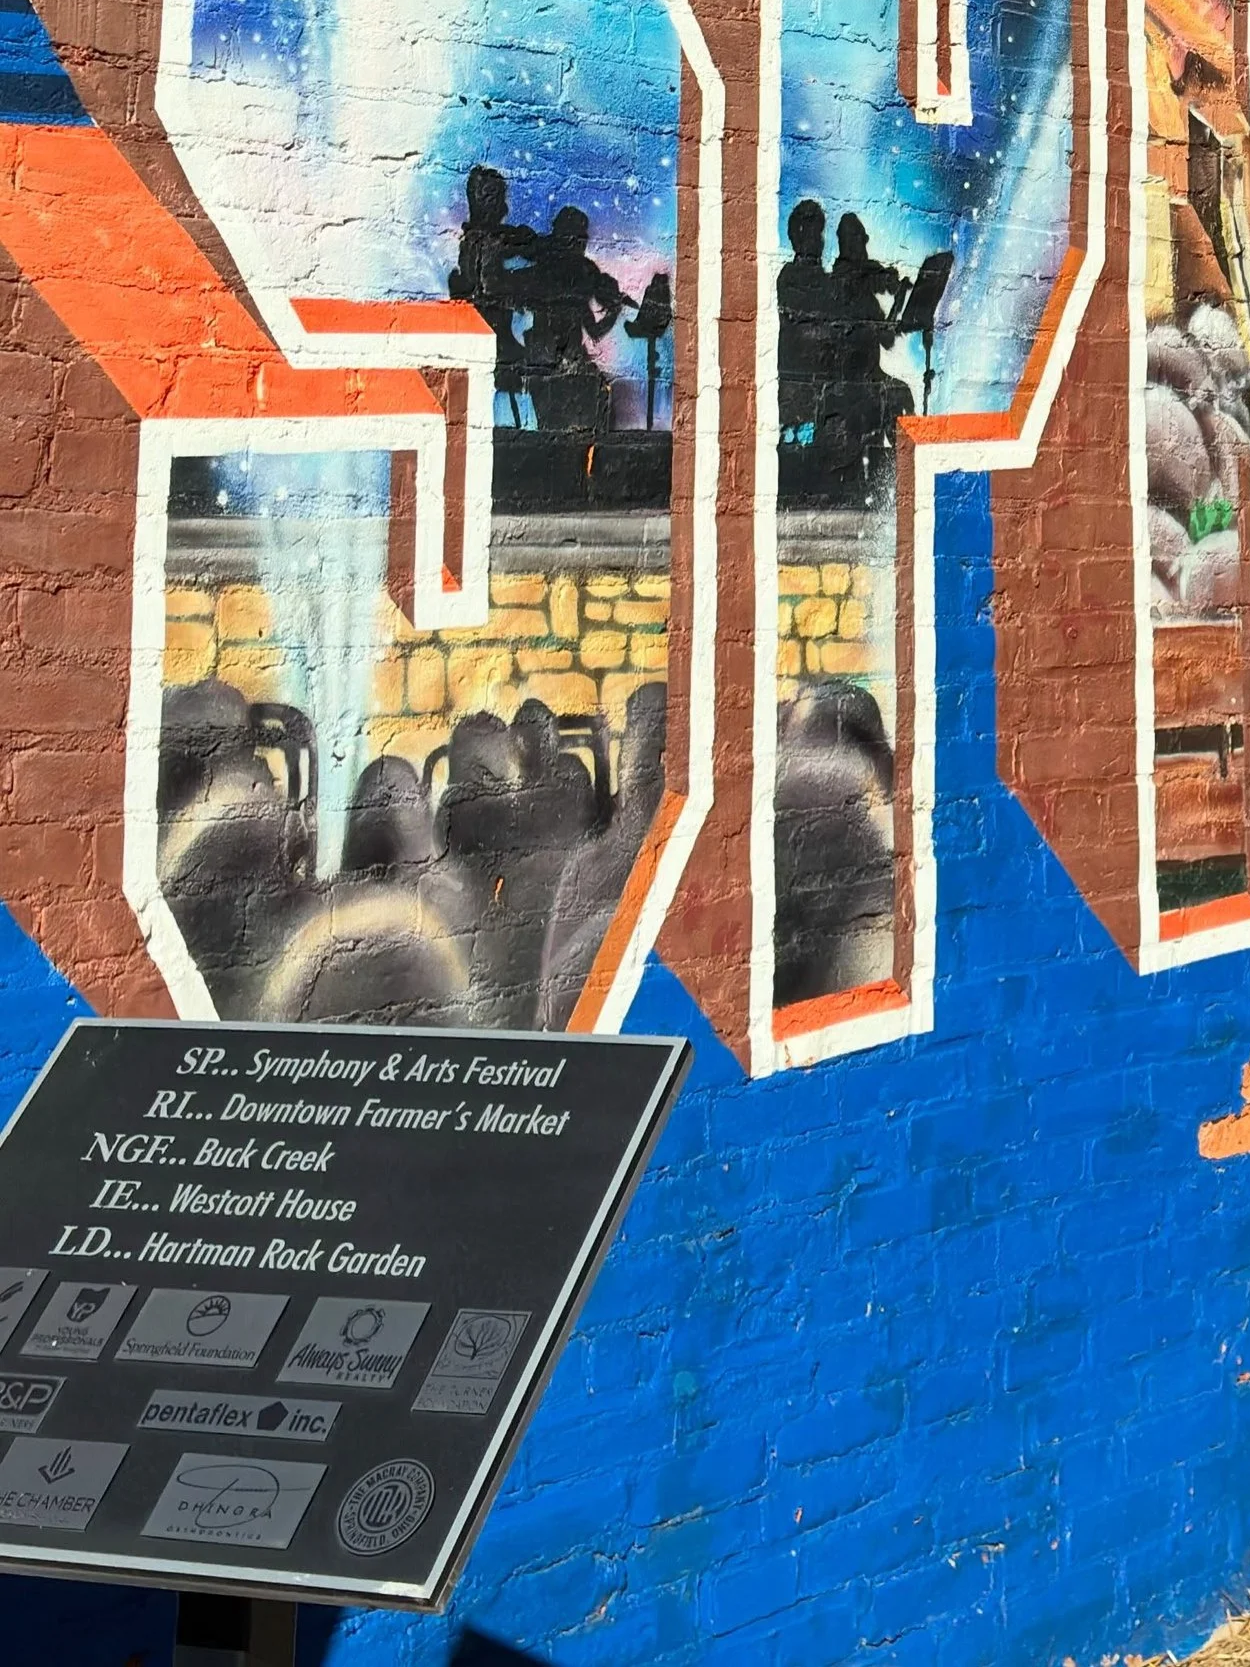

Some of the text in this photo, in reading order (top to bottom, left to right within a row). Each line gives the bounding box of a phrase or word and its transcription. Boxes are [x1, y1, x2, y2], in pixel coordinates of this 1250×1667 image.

[176, 1046, 567, 1087] SP... Symphony & Arts Festival
[143, 1090, 571, 1136] RI... Downtown Farmer's Market
[80, 1131, 335, 1172] NGF... Buck Creek
[89, 1179, 357, 1222] IE... Westcott House
[48, 1225, 427, 1278] LD... Hartman Rock Garden
[121, 1337, 256, 1361] Springfield Foundation
[287, 1342, 403, 1380] Always Sunny
[0, 1381, 53, 1411] &P
[141, 1402, 328, 1433] pentaflex inc.
[17, 1492, 96, 1513] CHAMBER
[178, 1500, 272, 1519] DHINGRA
